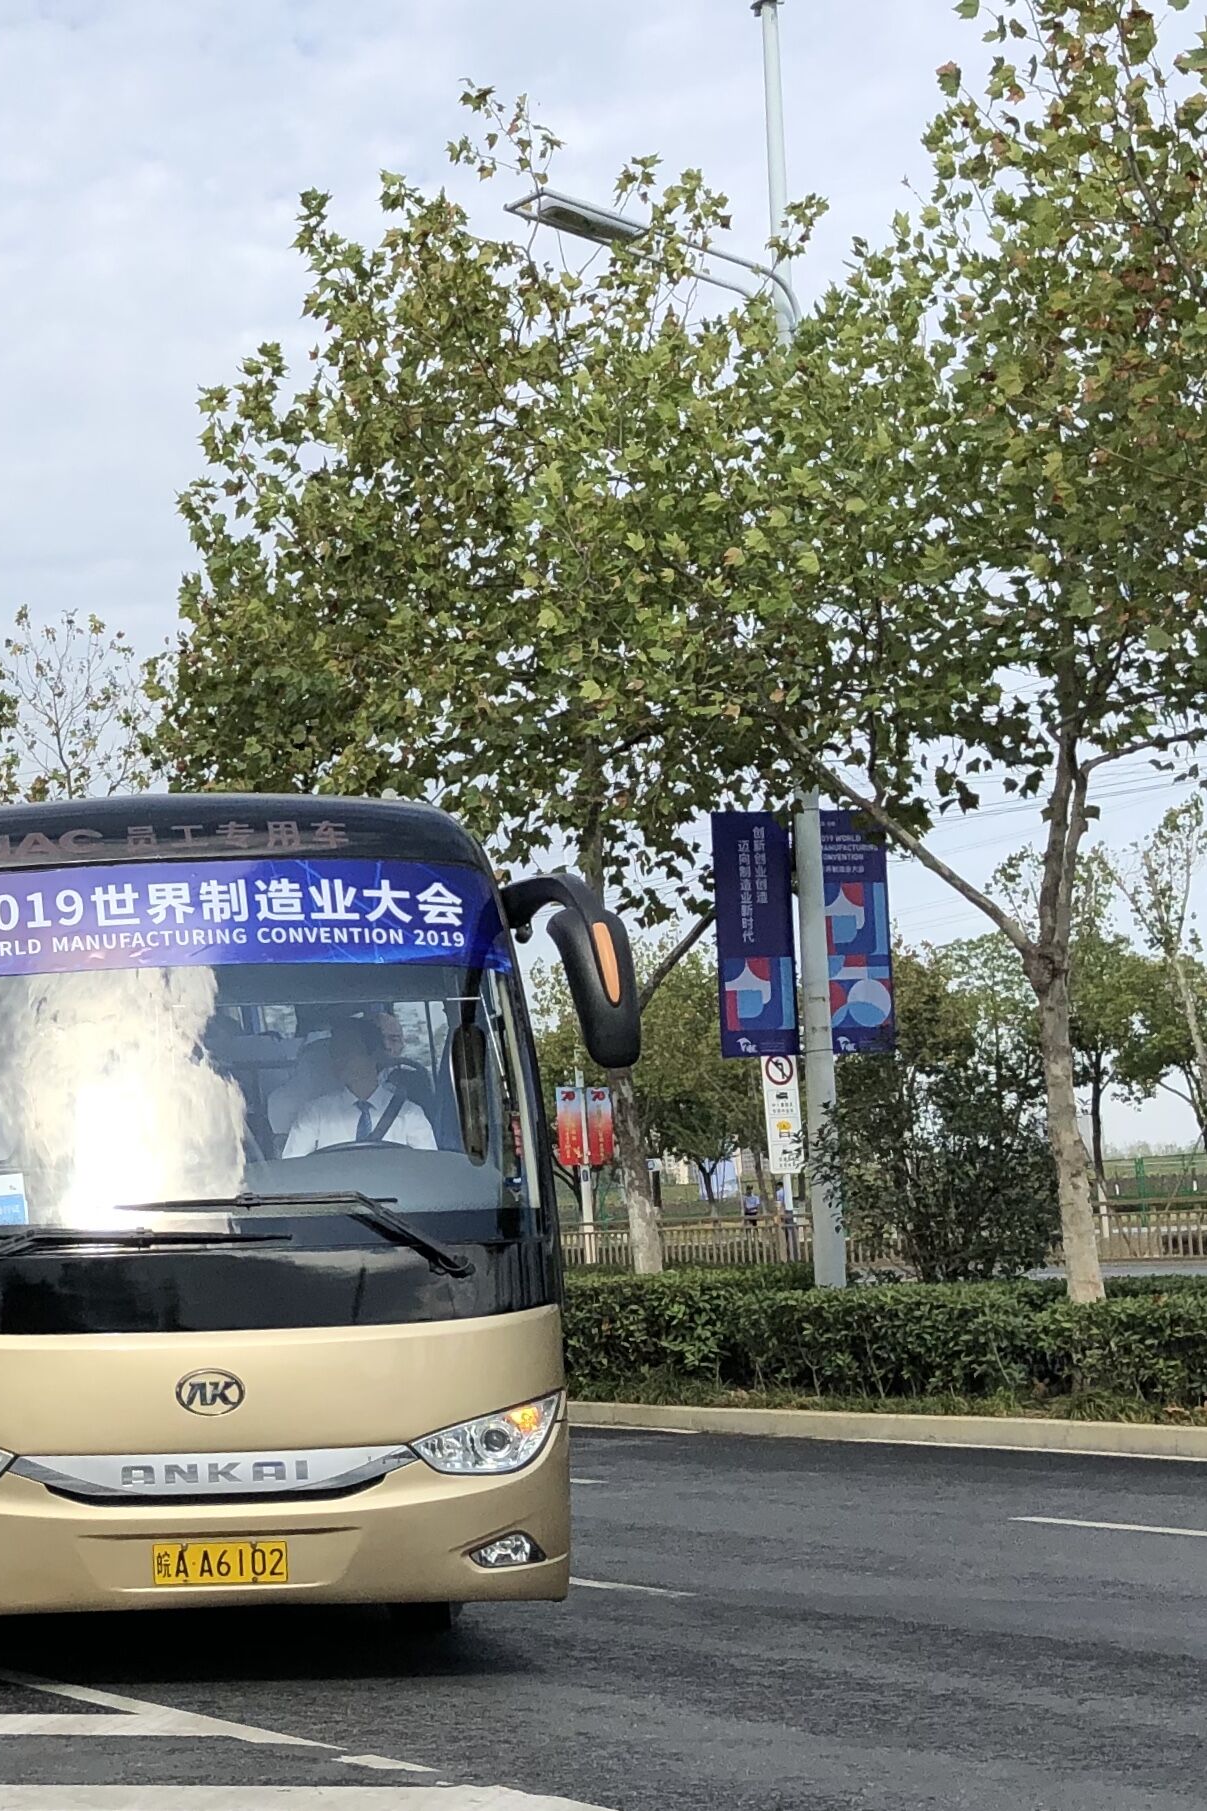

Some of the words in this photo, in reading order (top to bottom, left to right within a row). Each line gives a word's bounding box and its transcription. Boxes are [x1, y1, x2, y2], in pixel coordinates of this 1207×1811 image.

[126, 820, 349, 852] 员工专用车
[753, 826, 768, 904] 创新创业创造
[738, 840, 754, 943] 迈向制造业新时代
[52, 926, 248, 953] MANUFACTURING
[257, 926, 404, 946] CONVENTION
[413, 928, 465, 948] 2019
[120, 1459, 310, 1486] ANKAI
